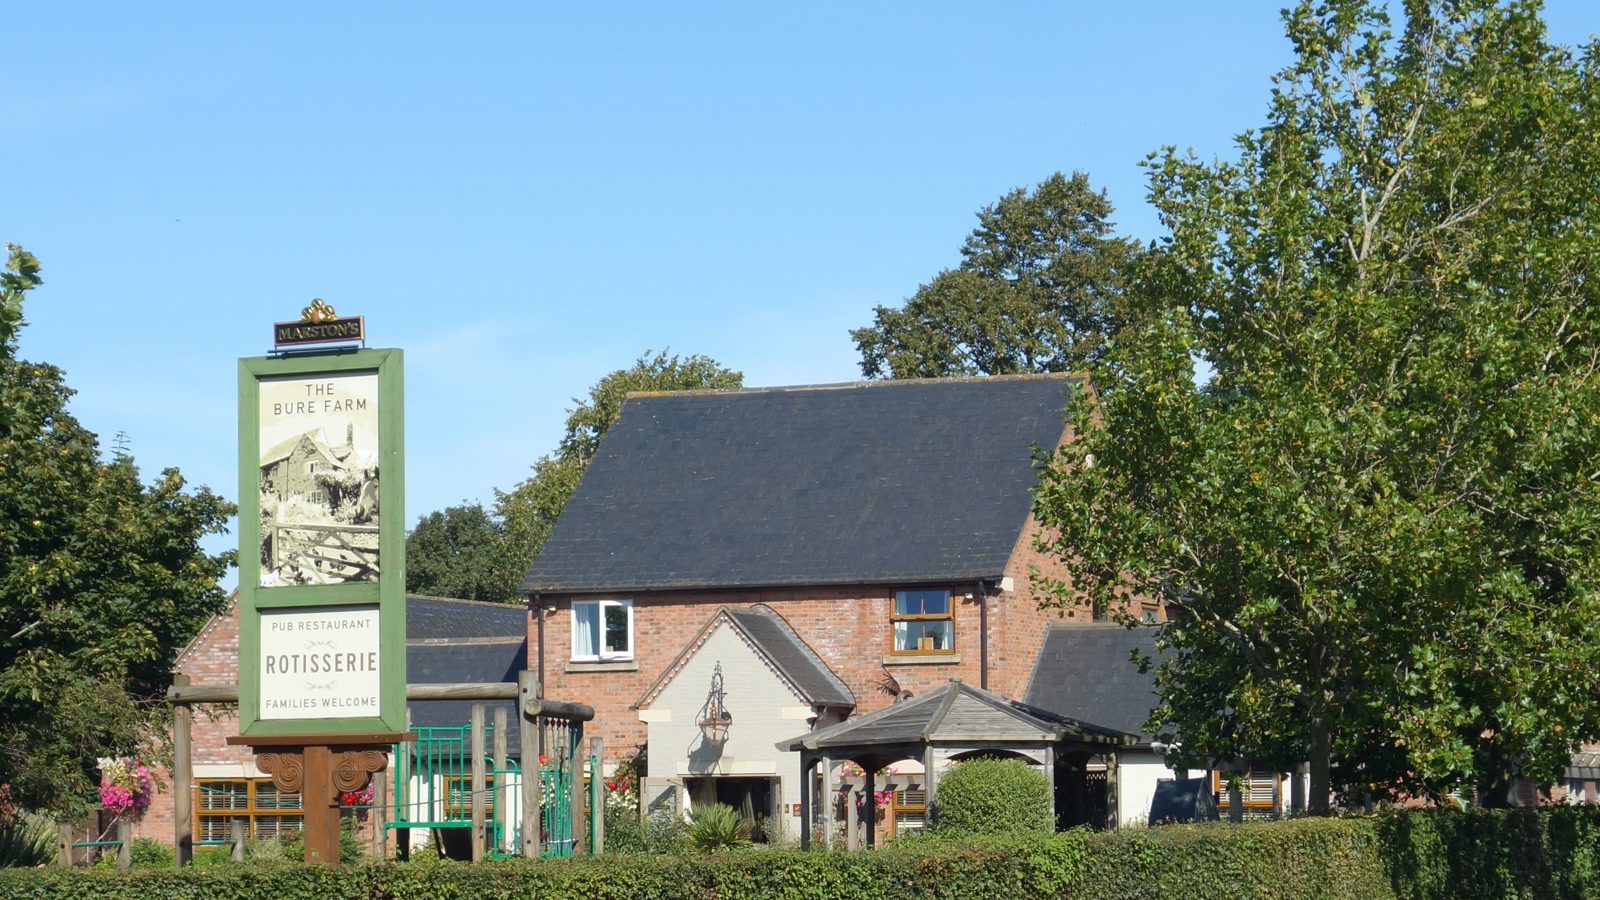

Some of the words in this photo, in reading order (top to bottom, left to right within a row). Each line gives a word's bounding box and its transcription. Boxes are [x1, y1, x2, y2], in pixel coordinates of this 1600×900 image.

[278, 322, 359, 340] MARSTON'S
[305, 383, 335, 396] THE
[274, 401, 316, 415] BURE
[324, 398, 367, 412] FARM
[272, 621, 294, 631] PUB
[298, 619, 371, 631] RESTAURANT
[266, 652, 377, 674] ROTISSERIE
[266, 698, 317, 708] FAMILIES
[322, 697, 377, 707] WELCOME
